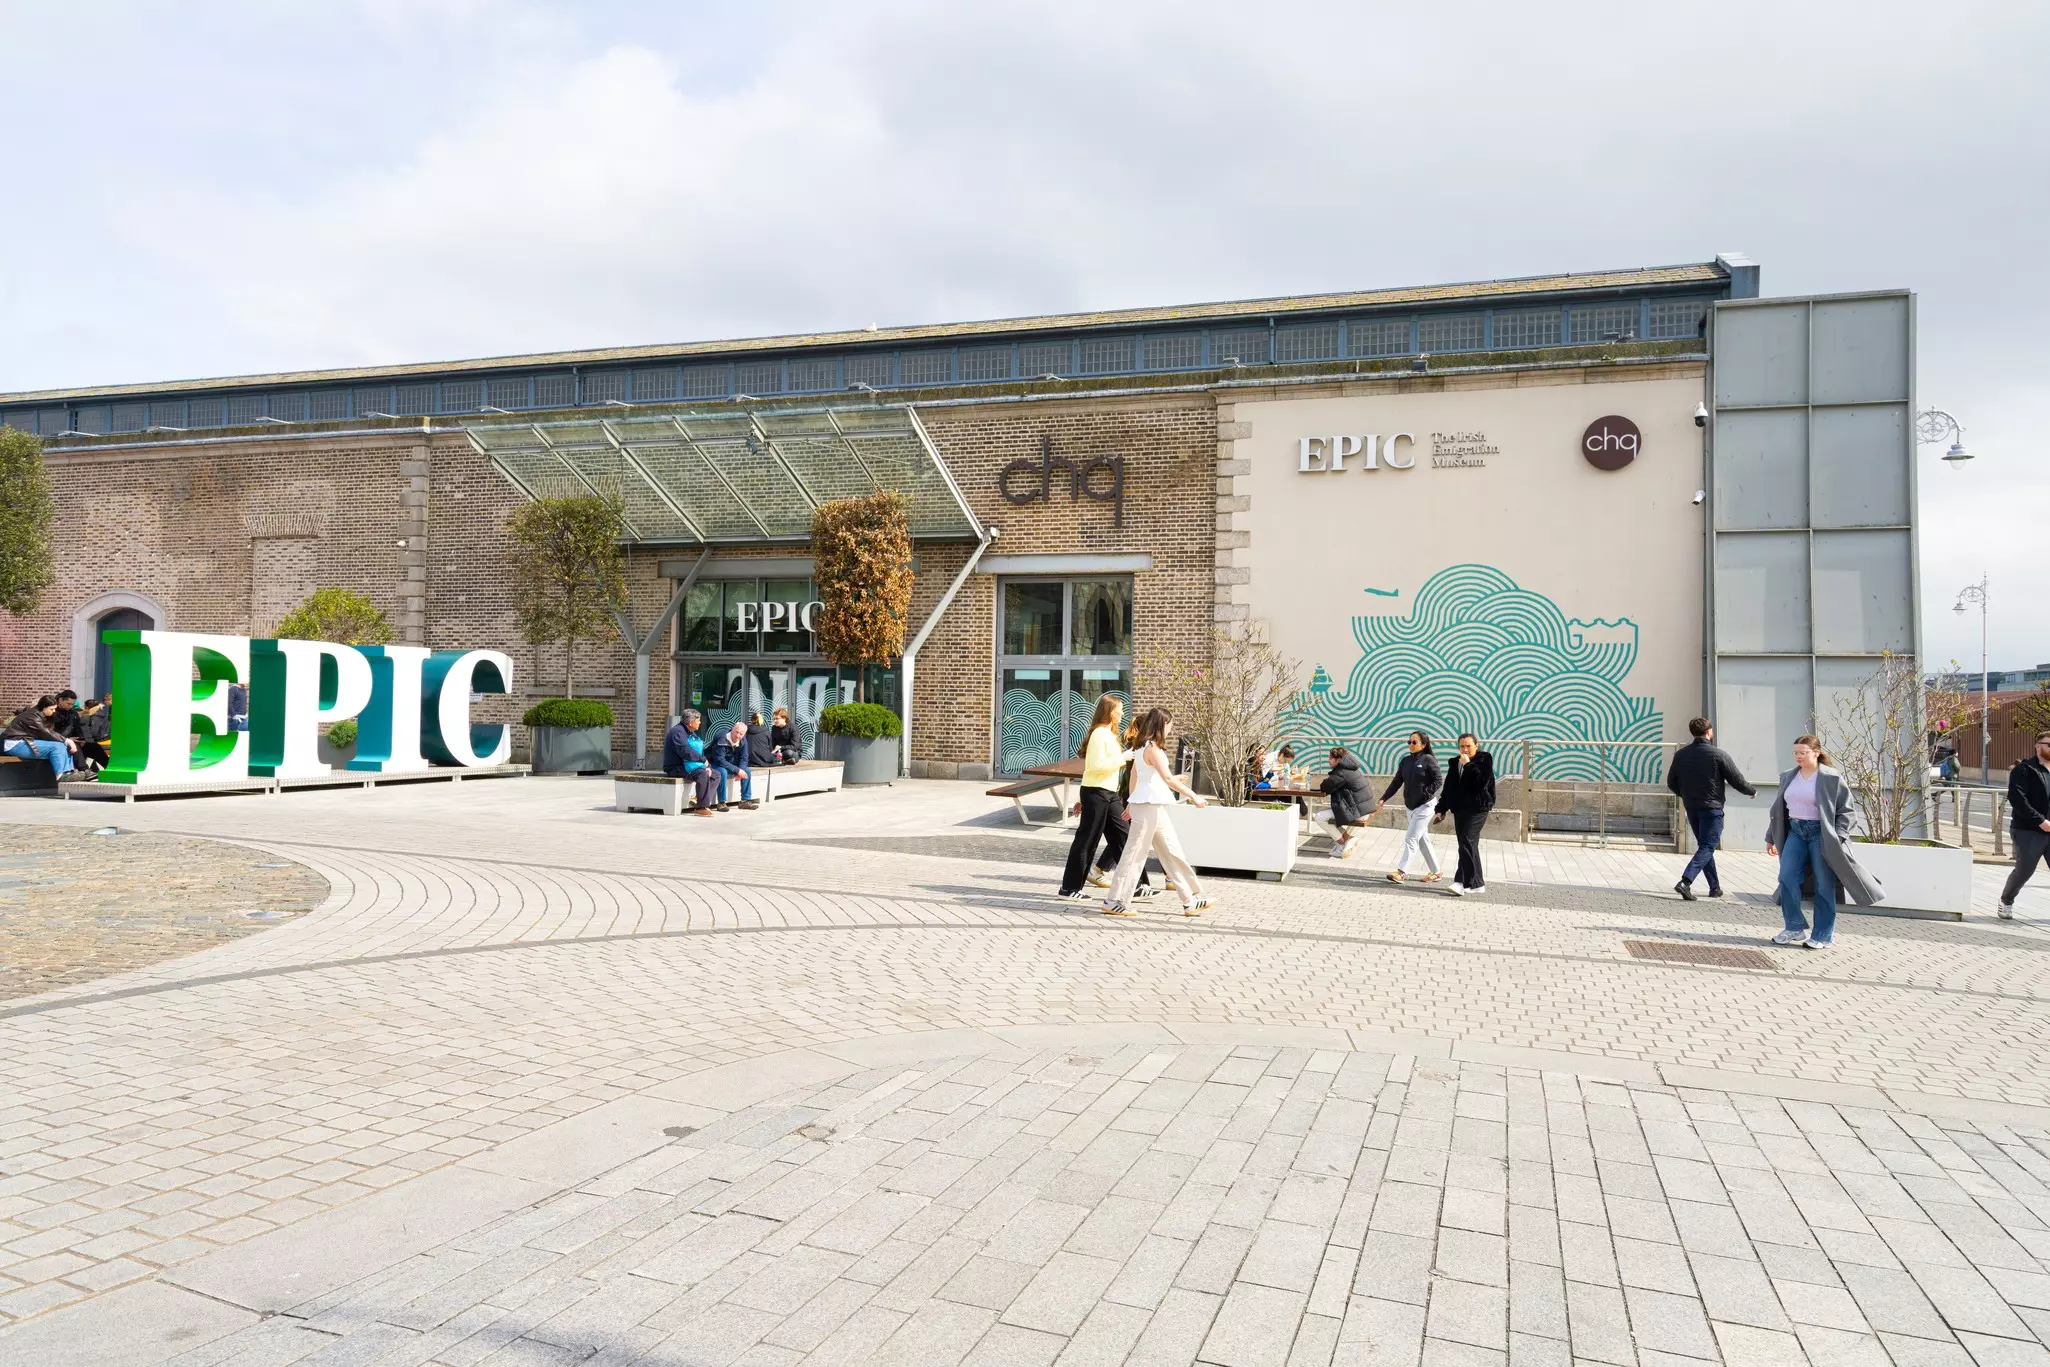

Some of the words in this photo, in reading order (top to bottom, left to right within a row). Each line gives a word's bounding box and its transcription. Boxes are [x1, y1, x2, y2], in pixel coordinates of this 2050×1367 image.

[1298, 432, 1416, 473] EPIC
[1431, 432, 1455, 443] The
[1457, 431, 1487, 443] Irish
[1432, 444, 1500, 458] Emigration
[1586, 426, 1637, 459] chq
[1432, 457, 1486, 469] Museum
[1000, 434, 1124, 529] chq
[736, 601, 826, 633] EPIC
[99, 629, 513, 785] EPIC
